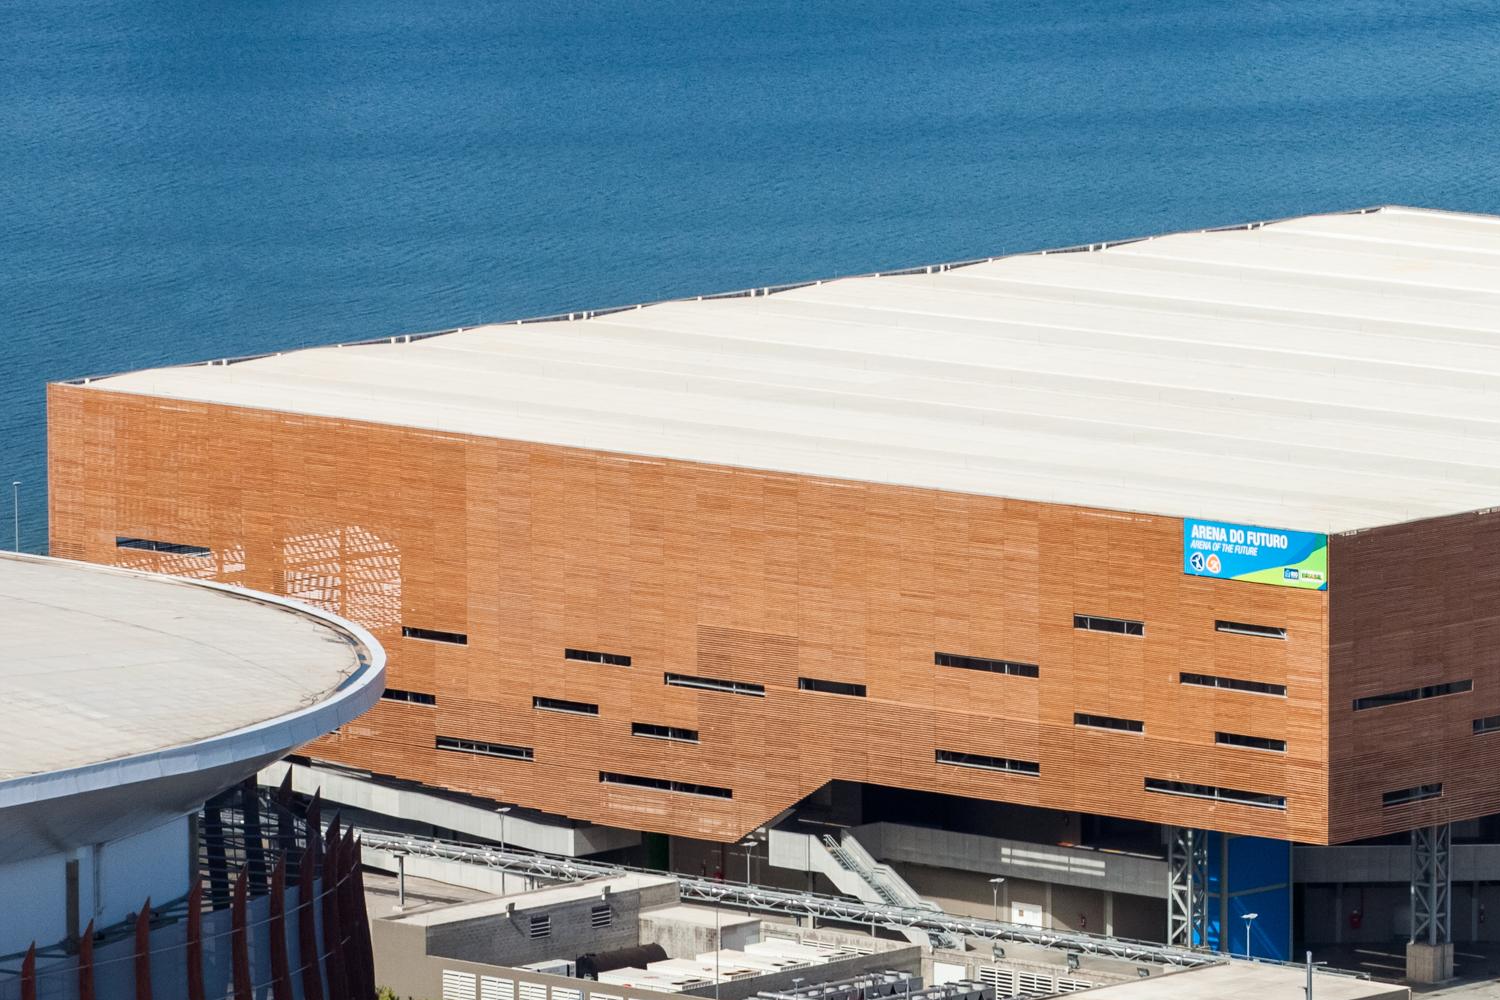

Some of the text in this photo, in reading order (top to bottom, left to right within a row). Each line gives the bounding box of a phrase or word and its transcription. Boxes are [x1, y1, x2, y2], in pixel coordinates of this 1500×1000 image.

[1191, 524, 1288, 549] ARENA DO FUTURO
[1190, 539, 1258, 556] ARENA OF THE FUTURE
